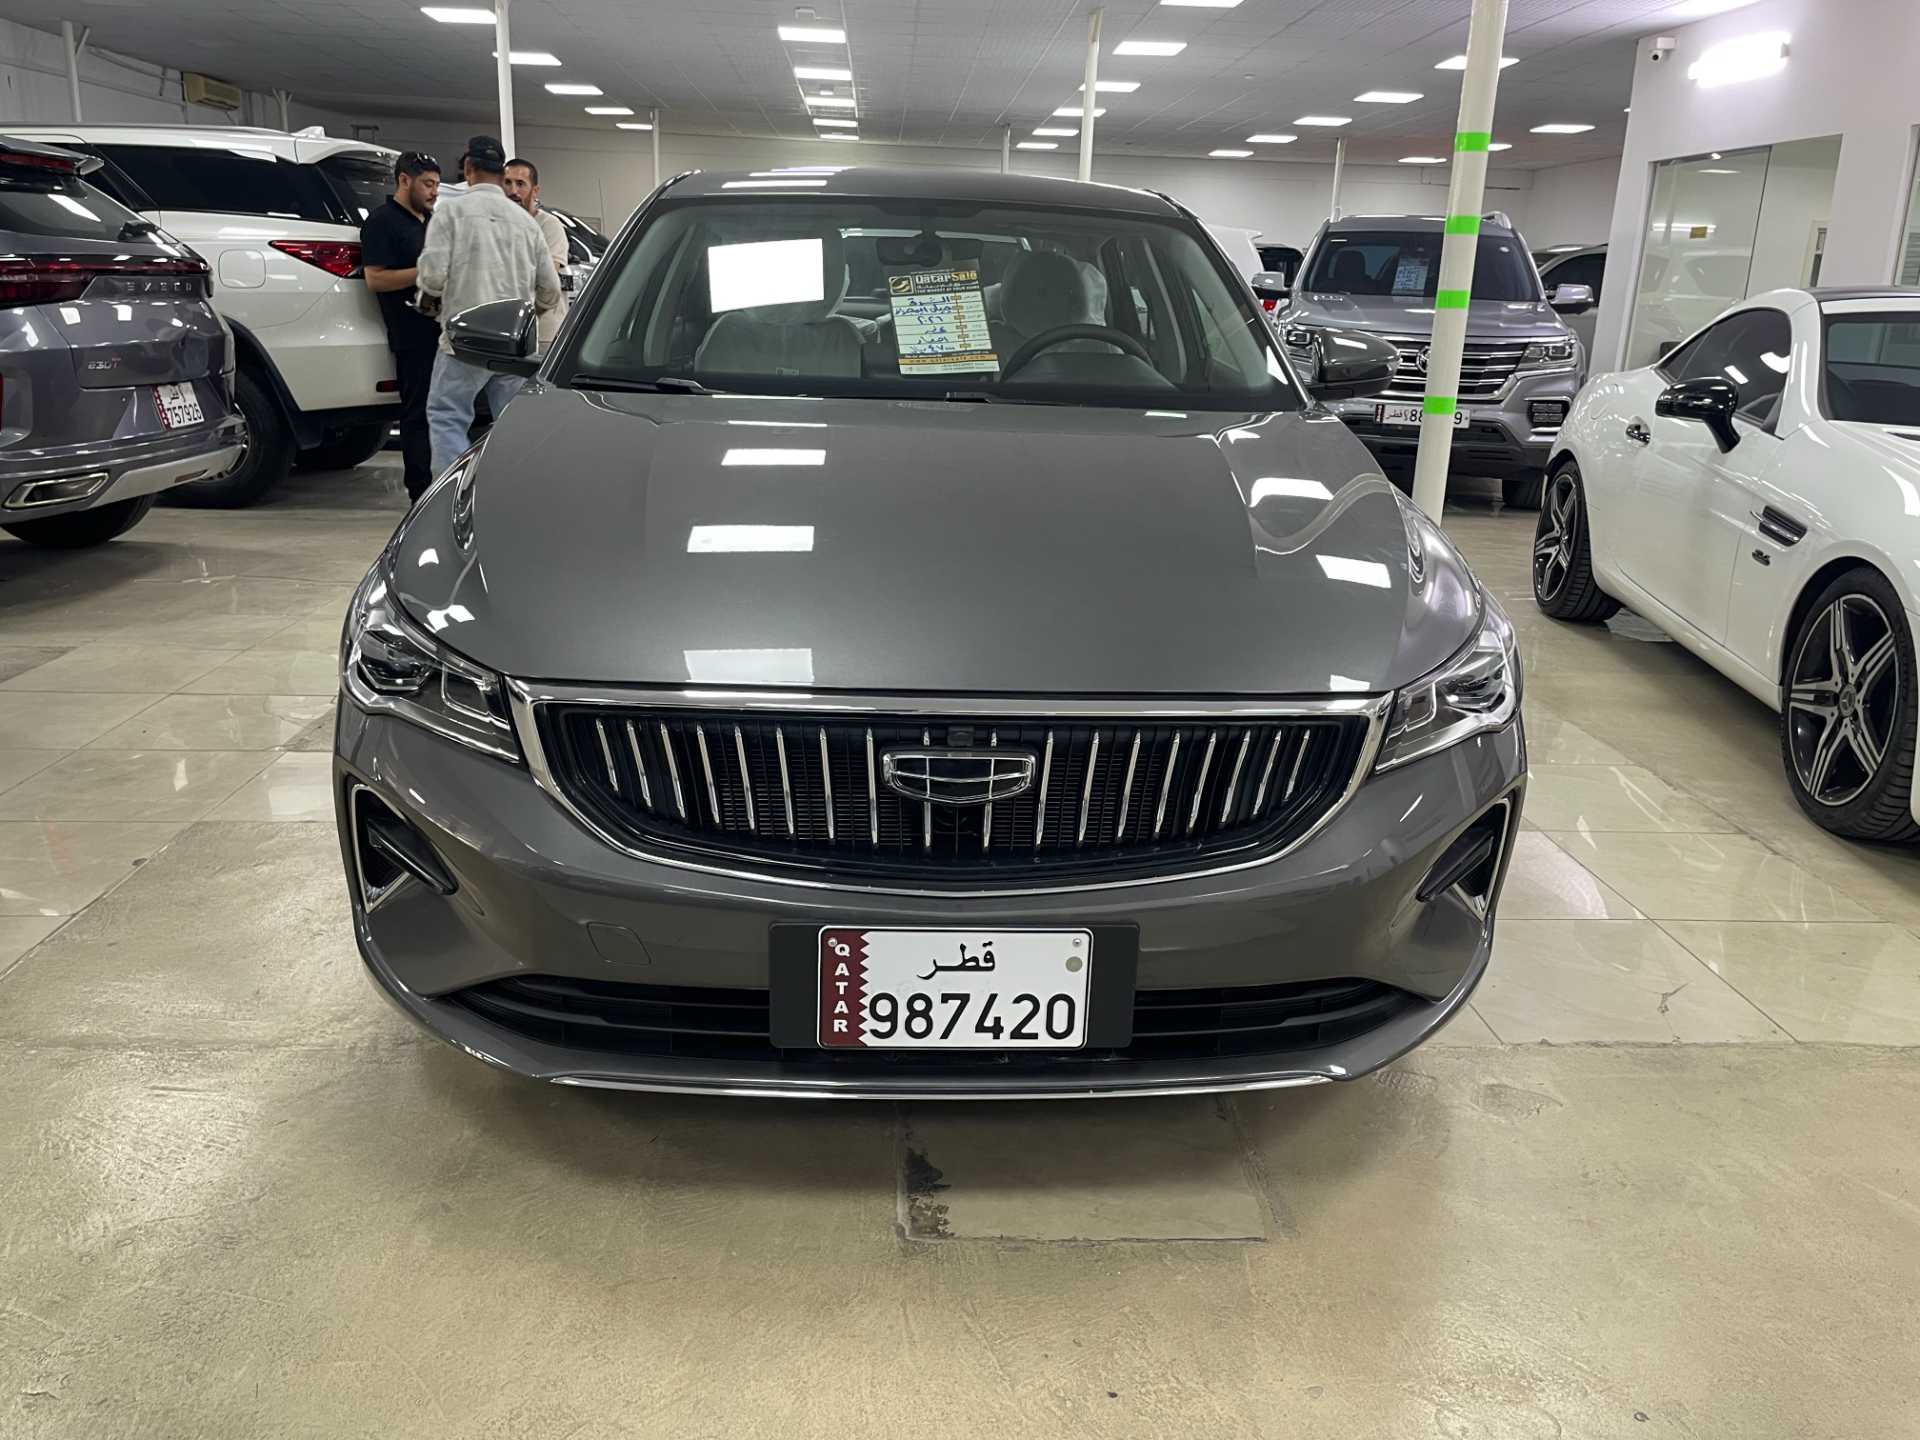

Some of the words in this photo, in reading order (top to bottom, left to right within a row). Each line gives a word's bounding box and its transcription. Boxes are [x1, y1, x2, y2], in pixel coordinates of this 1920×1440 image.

[917, 941, 995, 980] قطر
[833, 943, 850, 1033] QATAR
[868, 993, 1076, 1040] 987420
